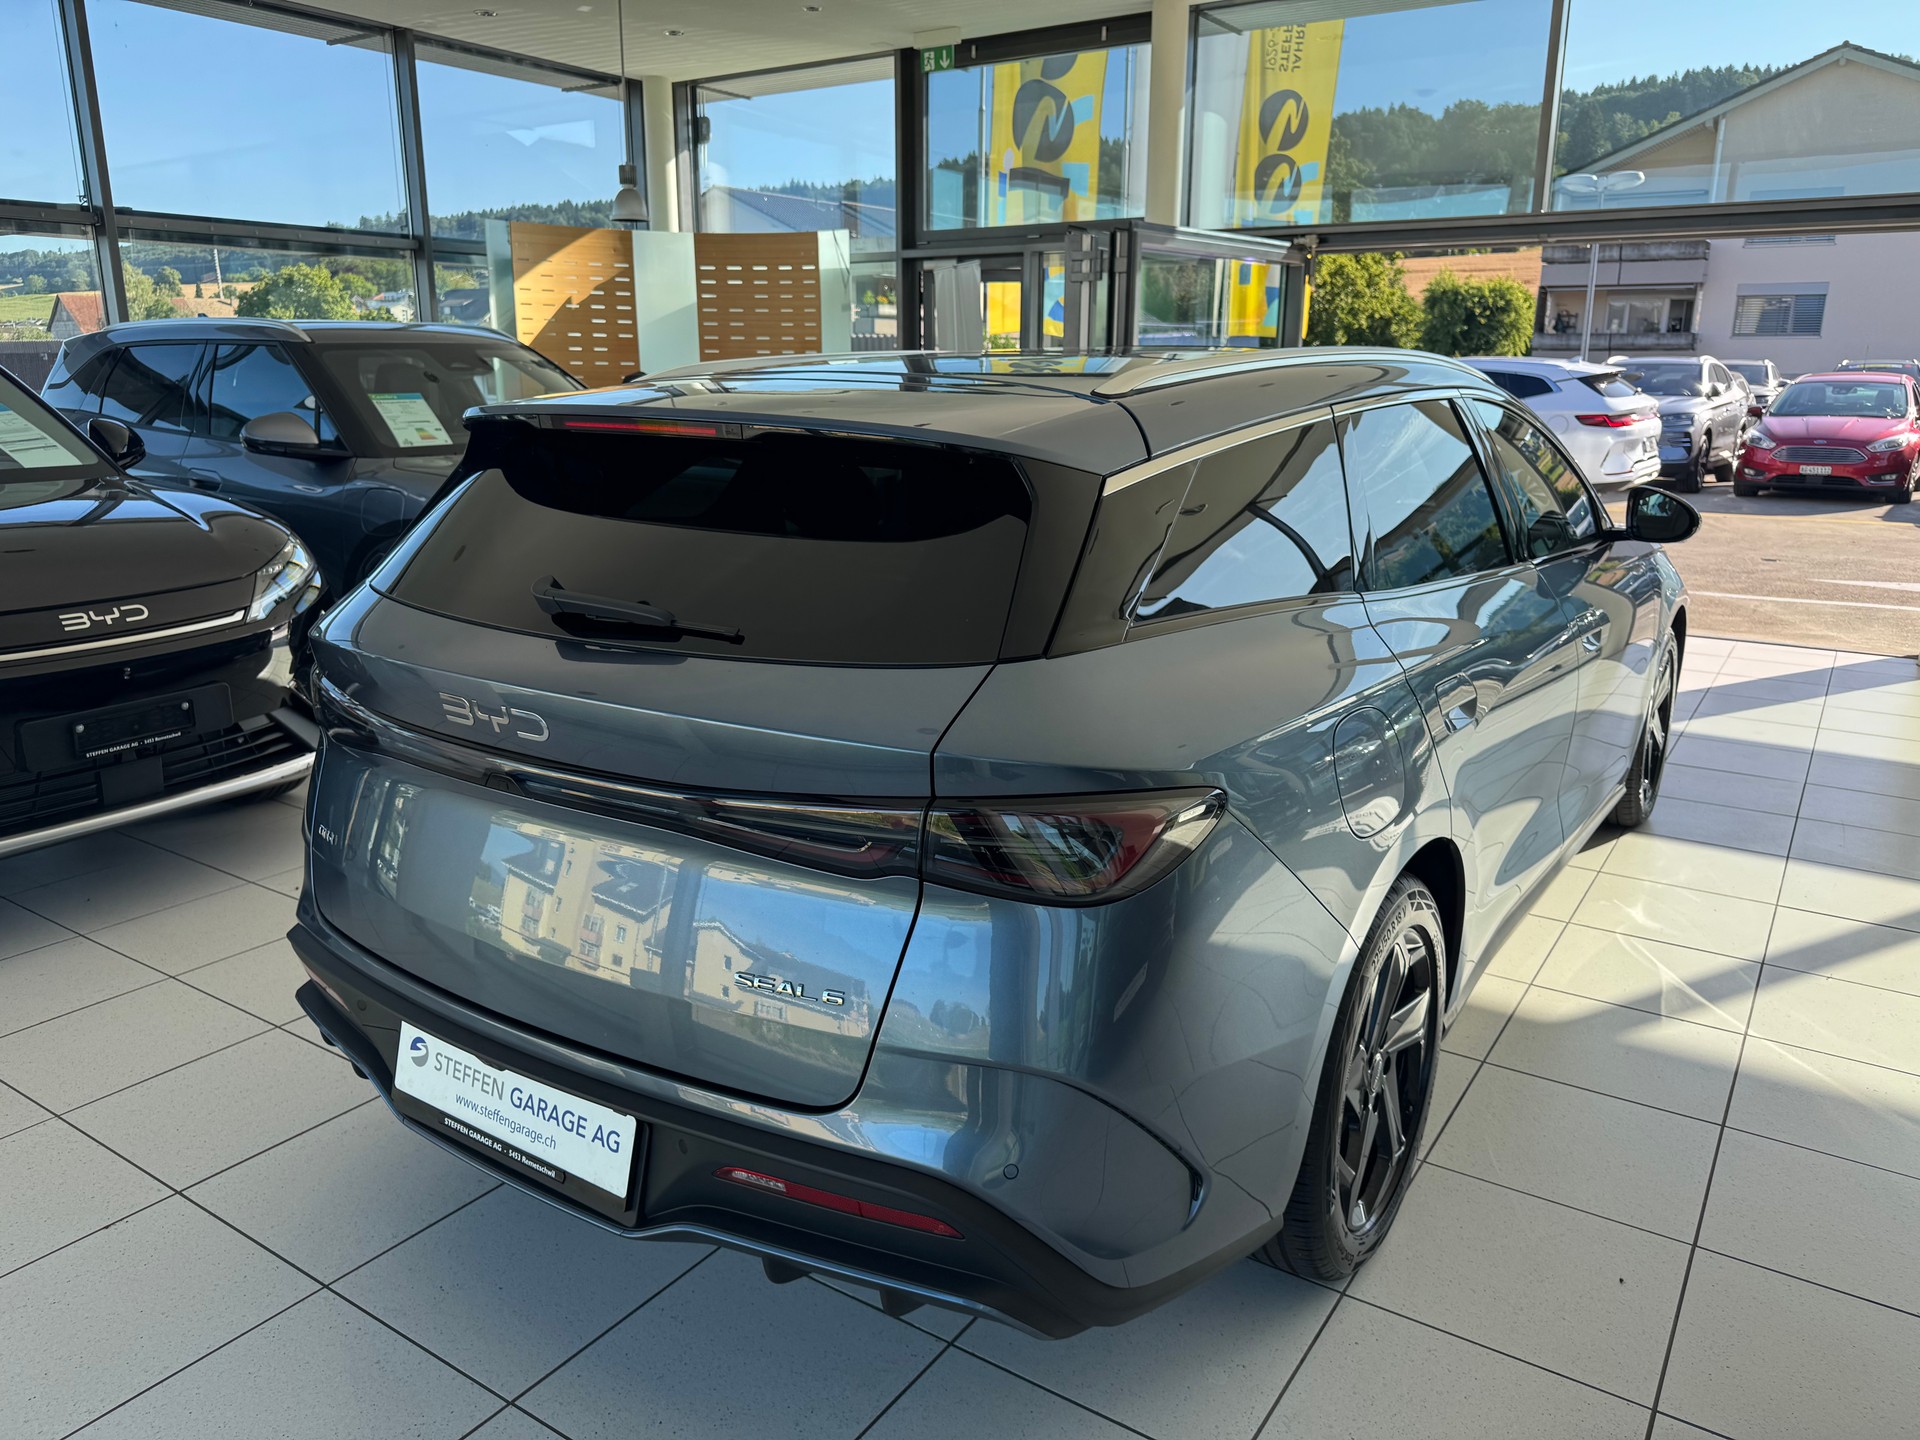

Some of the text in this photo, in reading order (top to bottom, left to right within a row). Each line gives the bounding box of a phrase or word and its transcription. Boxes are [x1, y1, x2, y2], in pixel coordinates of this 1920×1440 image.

[59, 604, 149, 631] BYD
[439, 692, 550, 742] BYD
[86, 748, 109, 758] STEFFEN
[109, 743, 130, 753] GARAGE
[734, 971, 845, 1006] SEAL 6
[434, 1052, 620, 1153] STEFFEN GARAGE AG
[455, 1093, 556, 1150] www.steffengarage.ch
[444, 1118, 556, 1178] STEFFEN GARAGE AG 5453 Remetschwil
